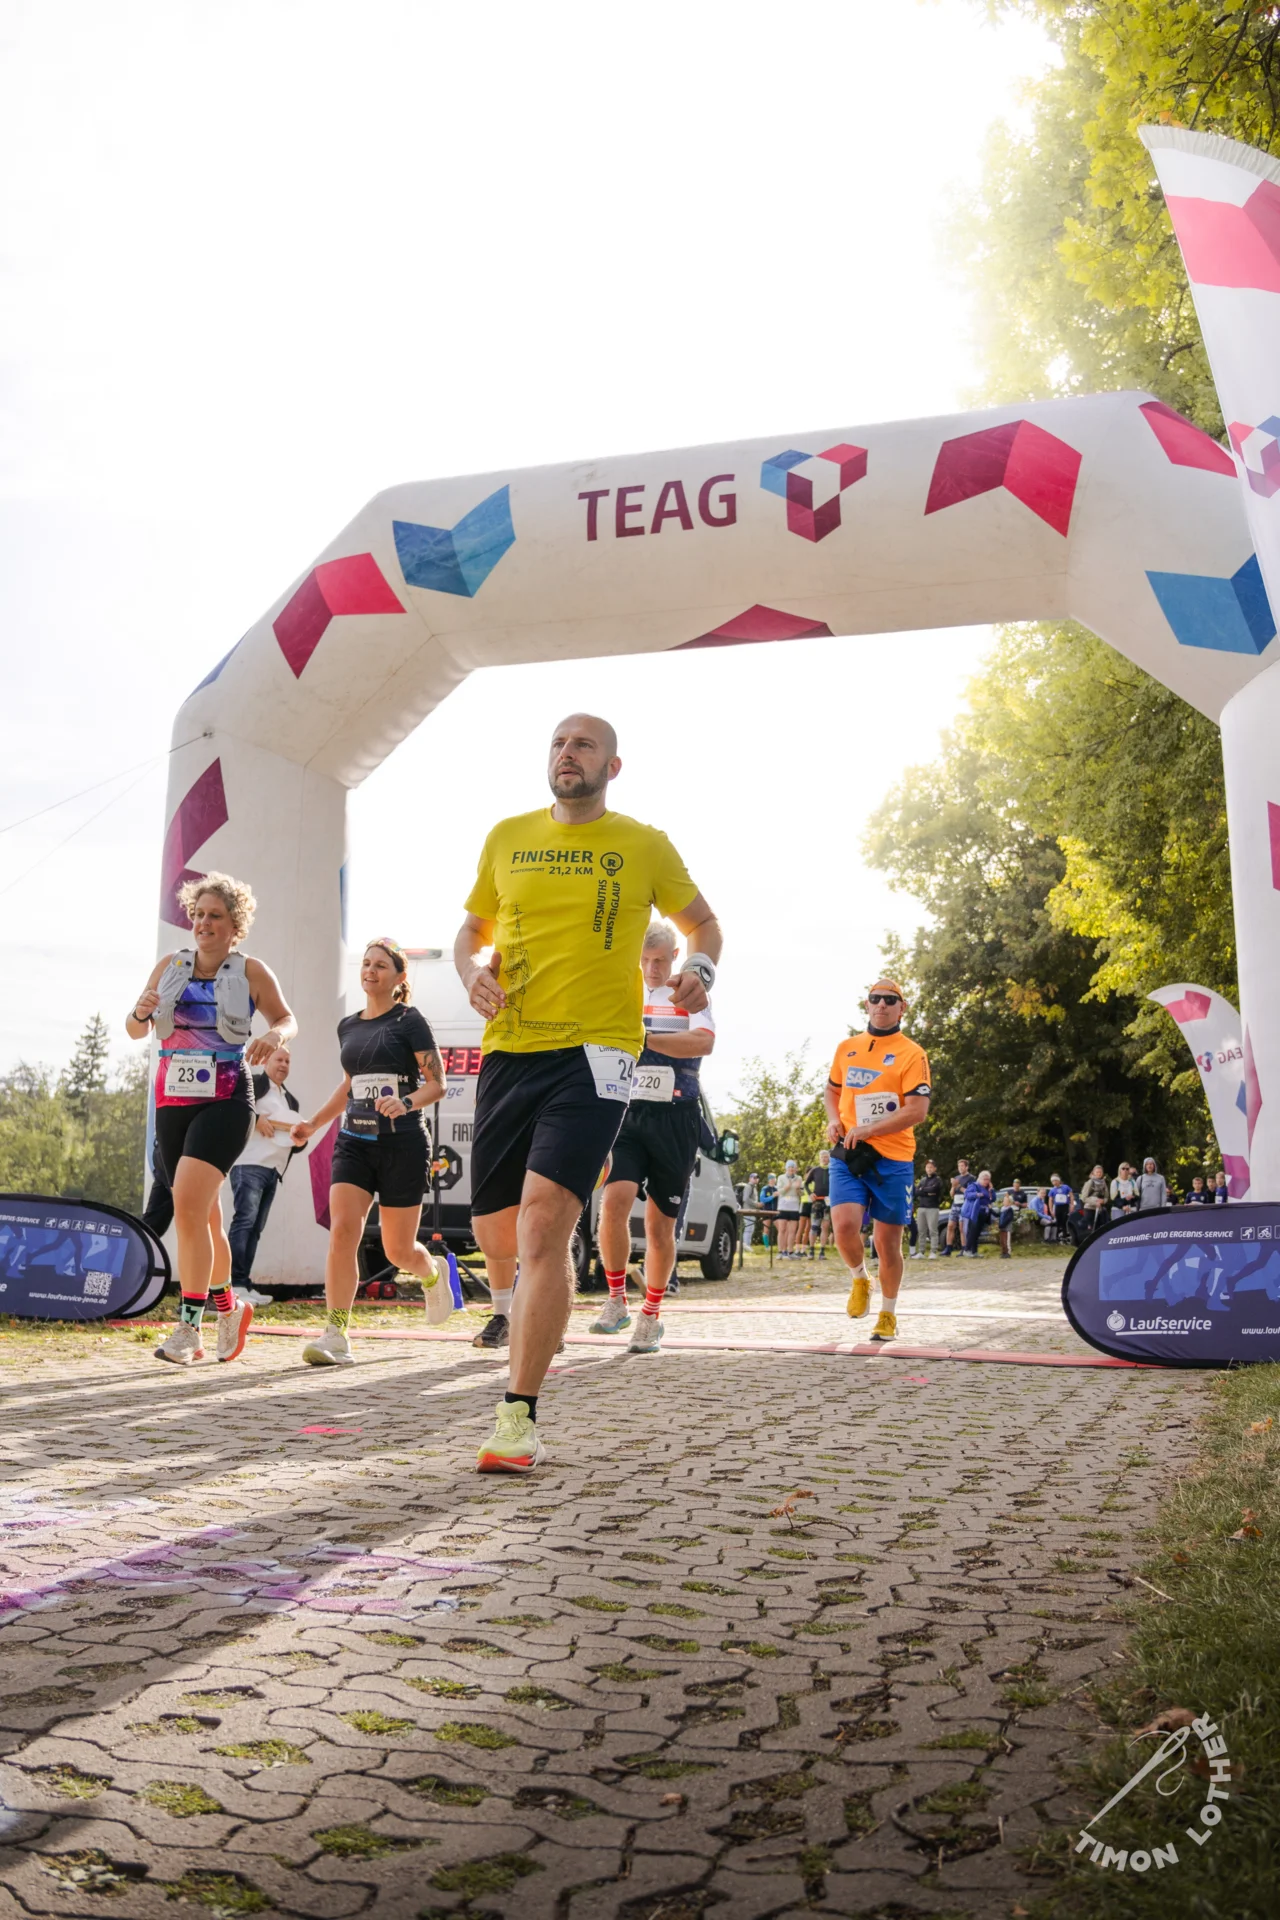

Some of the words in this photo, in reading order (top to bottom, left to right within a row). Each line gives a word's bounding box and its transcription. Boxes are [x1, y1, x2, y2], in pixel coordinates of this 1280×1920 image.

[577, 473, 737, 542] TEAG
[512, 850, 593, 864] FINISHER
[549, 866, 571, 876] 21,2
[575, 867, 593, 875] KM
[593, 879, 607, 932] GUTSMUTHS
[604, 881, 620, 950] RENNSTEIGLAUF
[178, 1067, 195, 1083] 23
[638, 1075, 661, 1090] 220
[847, 1069, 873, 1086] SAP
[365, 1085, 379, 1099] 20
[870, 1102, 885, 1115] 25
[452, 1122, 473, 1142] FIAT
[1108, 1233, 1152, 1245] ZEITNAHME-
[1153, 1231, 1168, 1240] UND
[1169, 1230, 1234, 1239] ERGEBNIS-SERVICE
[1129, 1316, 1212, 1331] Laufservice
